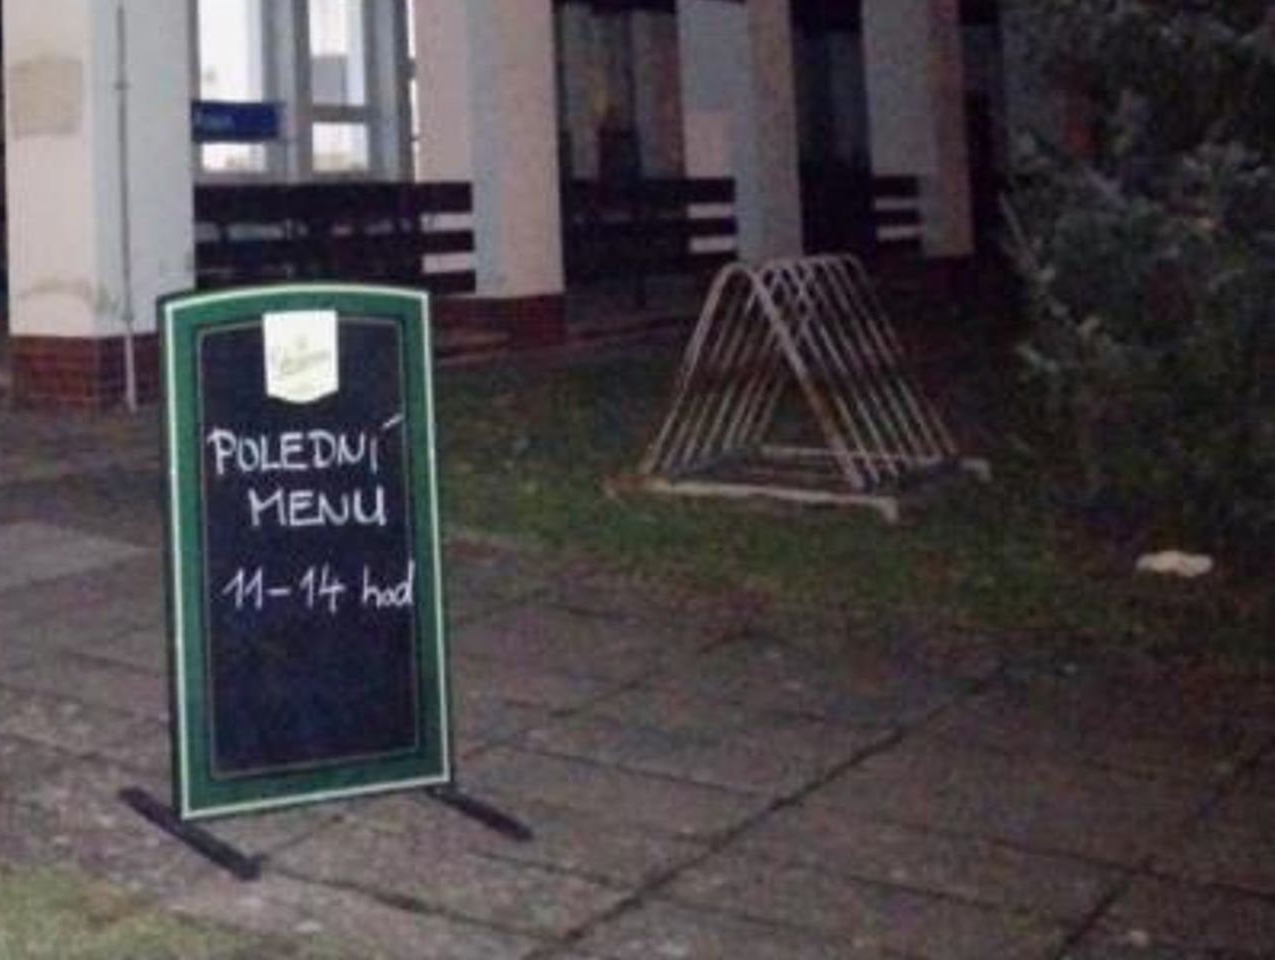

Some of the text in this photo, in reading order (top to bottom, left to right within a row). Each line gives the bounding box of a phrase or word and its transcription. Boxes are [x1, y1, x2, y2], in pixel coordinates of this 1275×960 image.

[207, 413, 403, 475] POLEDNÍ
[248, 486, 387, 526] MENU
[363, 559, 415, 607] hod
